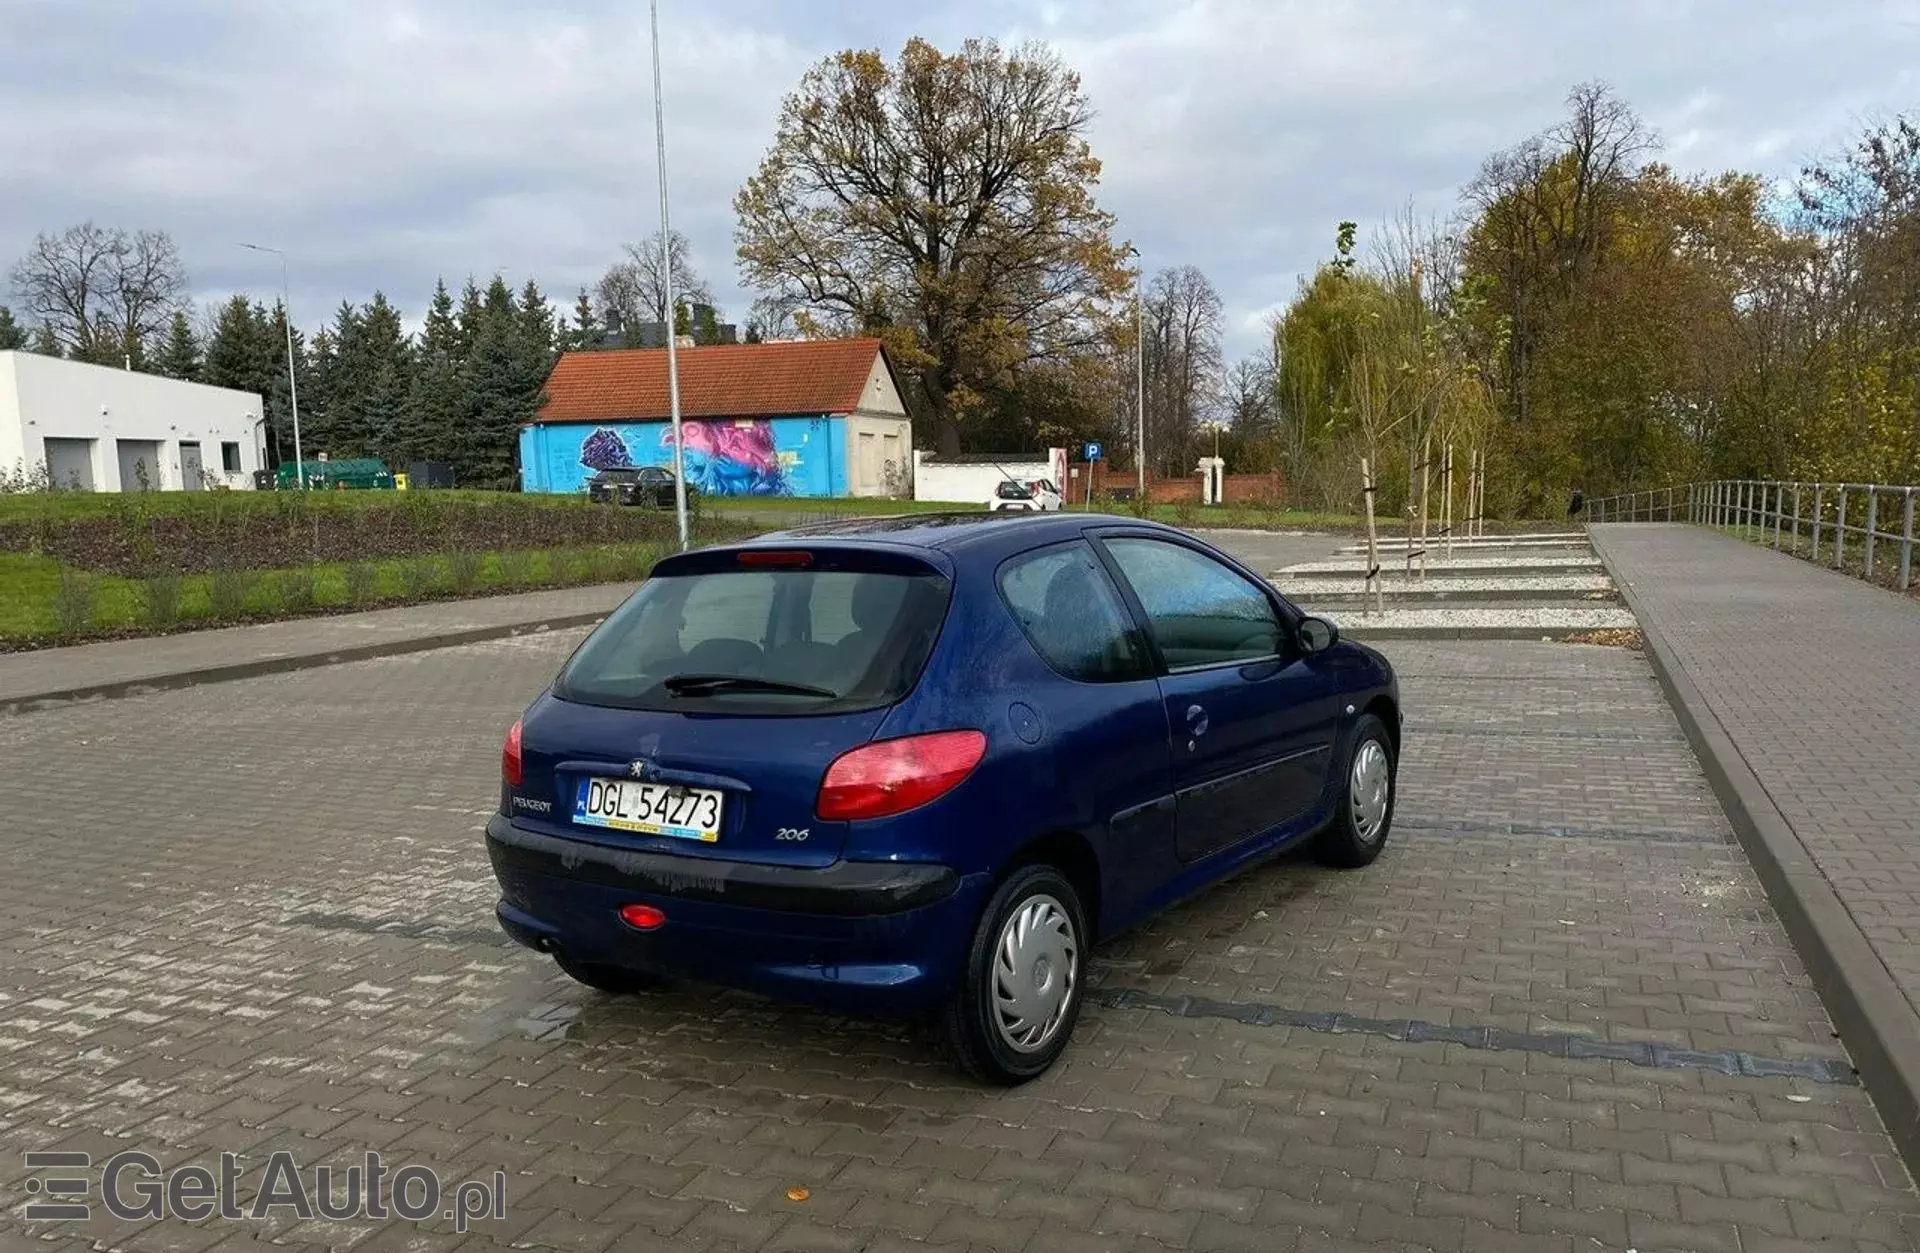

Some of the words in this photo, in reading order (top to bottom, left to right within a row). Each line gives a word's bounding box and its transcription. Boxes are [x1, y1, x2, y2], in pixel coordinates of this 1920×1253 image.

[1089, 446, 1097, 456] P
[512, 796, 552, 813] PEUGEOT
[577, 800, 585, 810] PL
[588, 781, 628, 818] DGL
[638, 787, 718, 828] 54273
[776, 828, 810, 841] 206
